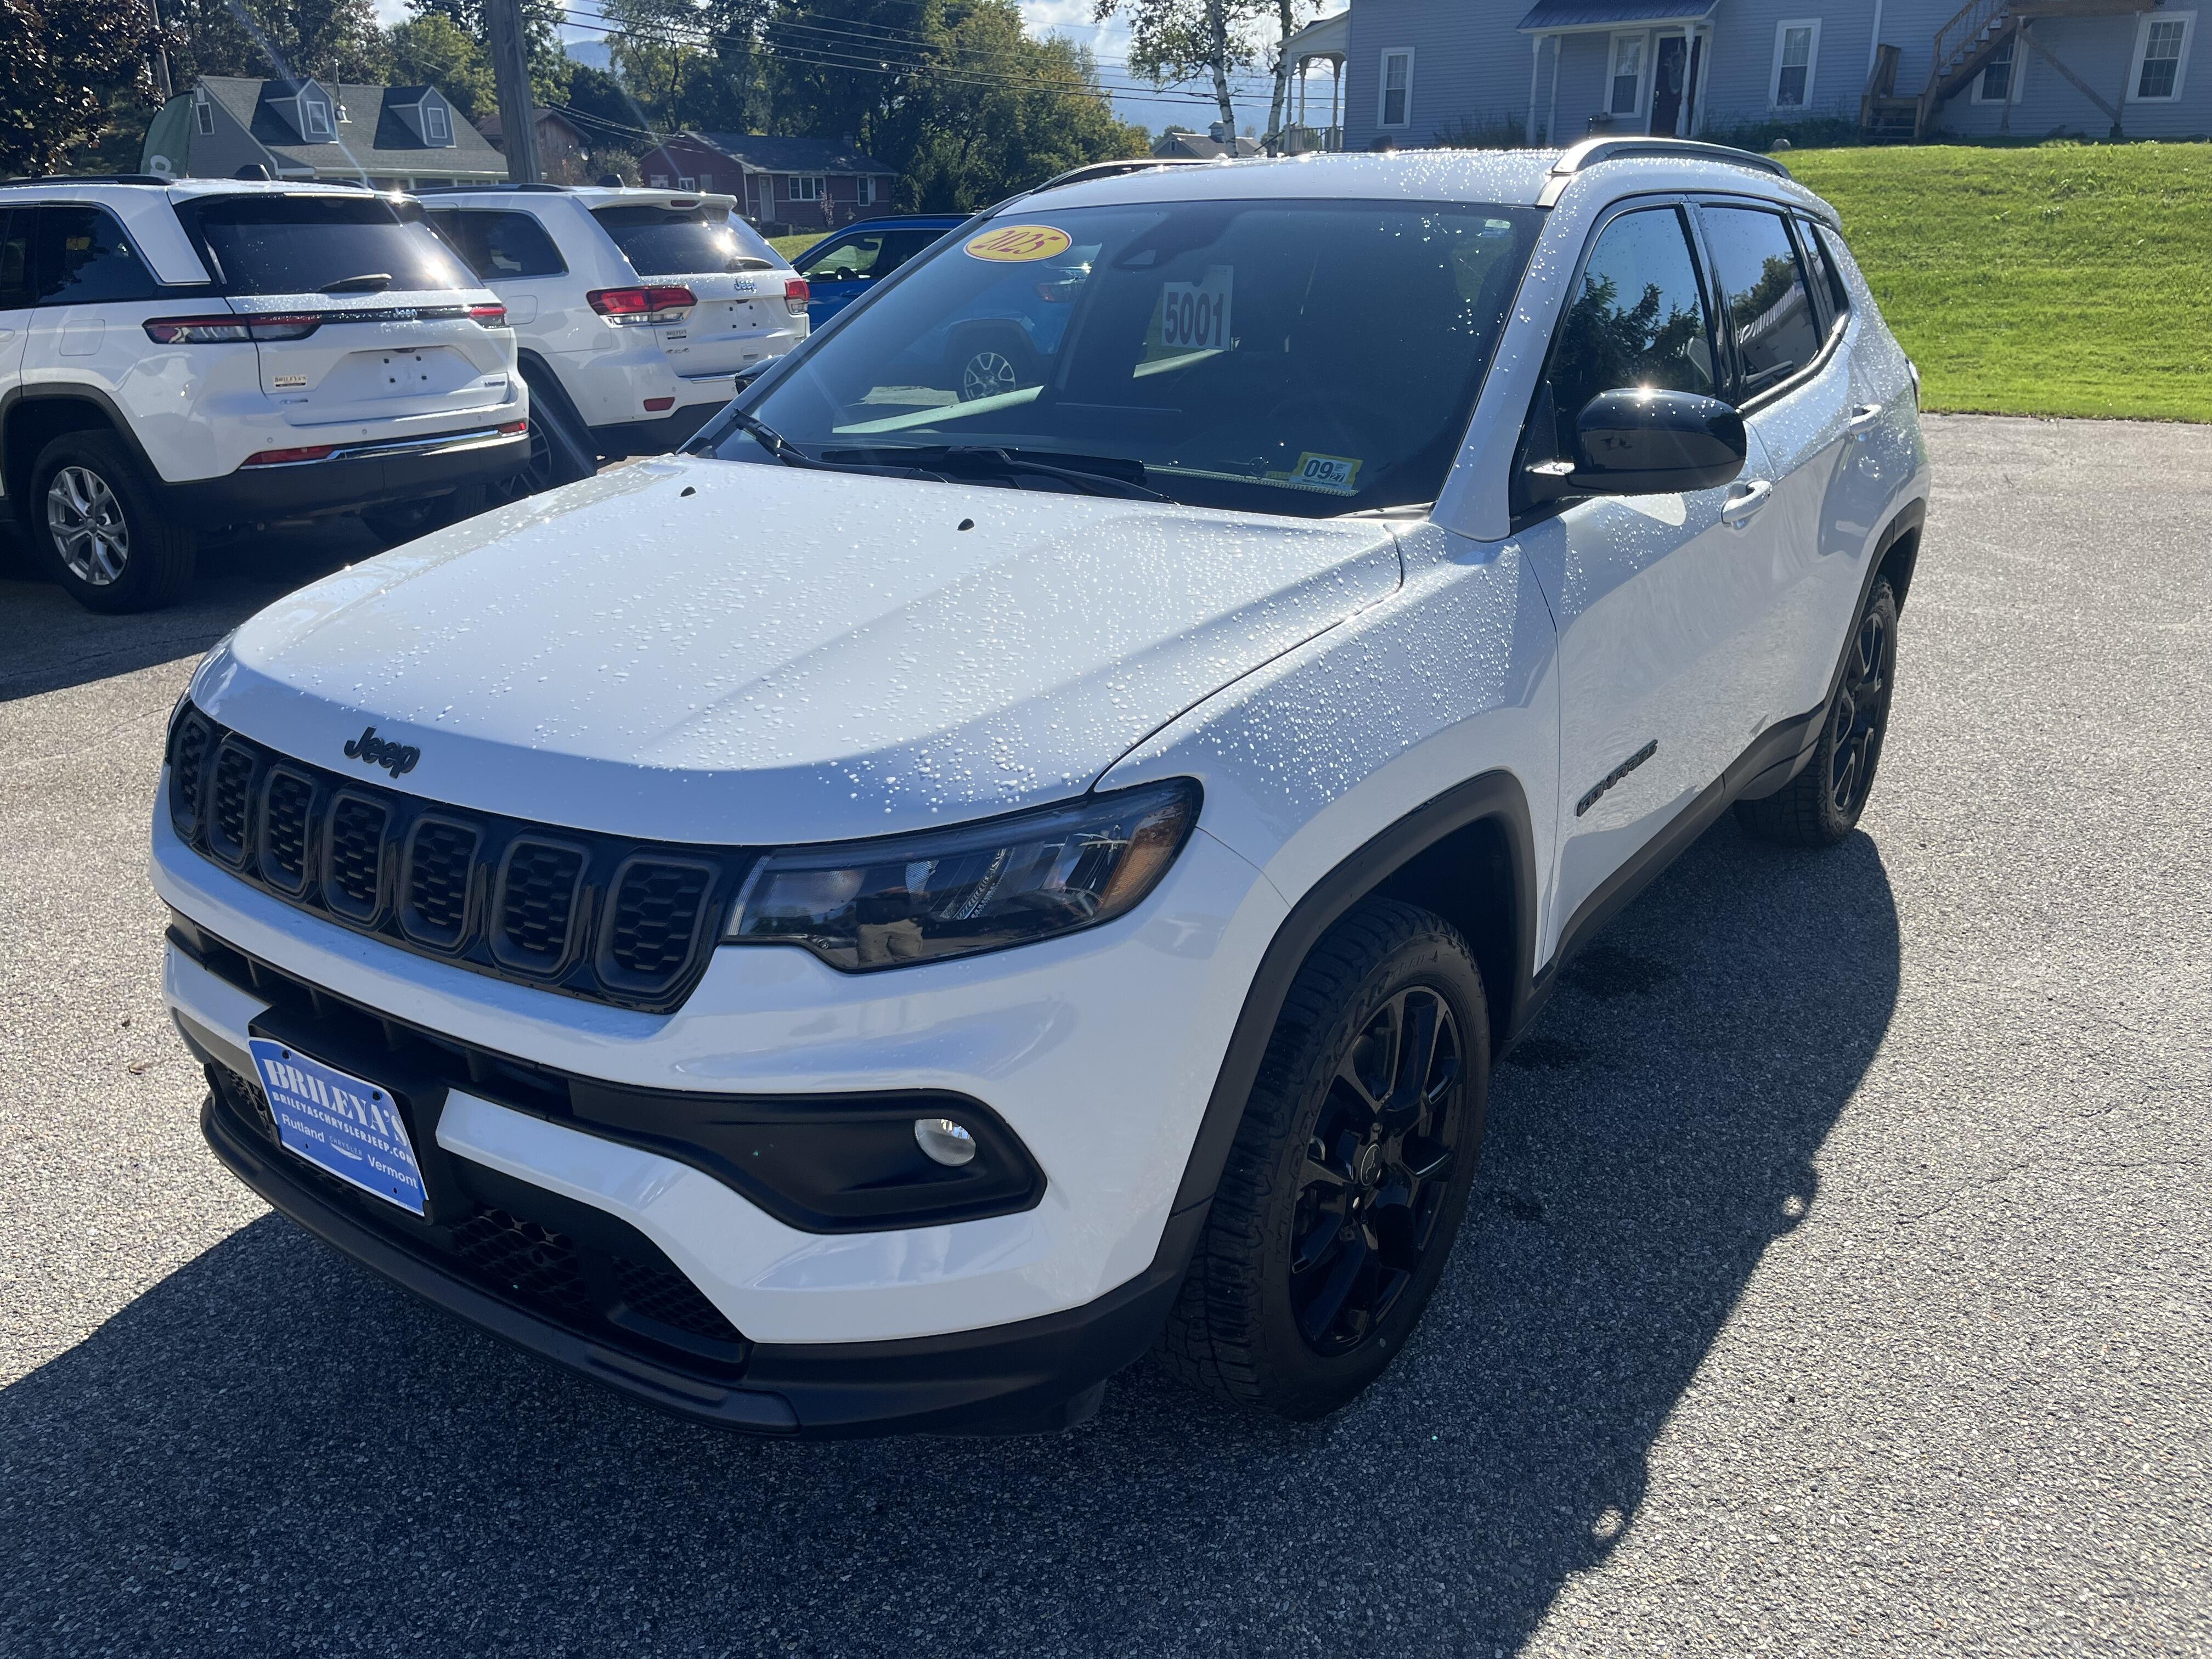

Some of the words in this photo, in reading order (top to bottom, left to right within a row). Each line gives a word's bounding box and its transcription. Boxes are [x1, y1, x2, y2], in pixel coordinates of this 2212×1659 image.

[972, 230, 1062, 255] 2025
[733, 278, 757, 294] Jeep
[392, 308, 418, 319] Jeep
[1164, 292, 1224, 346] 5001
[1304, 460, 1334, 479] 09
[344, 726, 420, 778] Jeep
[262, 1059, 408, 1147] BRILEYA'S
[272, 1092, 414, 1166] BRILEYASCHRYSLERJEEP.COM
[281, 1113, 325, 1143] Rutland
[329, 1135, 363, 1156] CHRYSLER
[368, 1154, 419, 1189] Vermont
